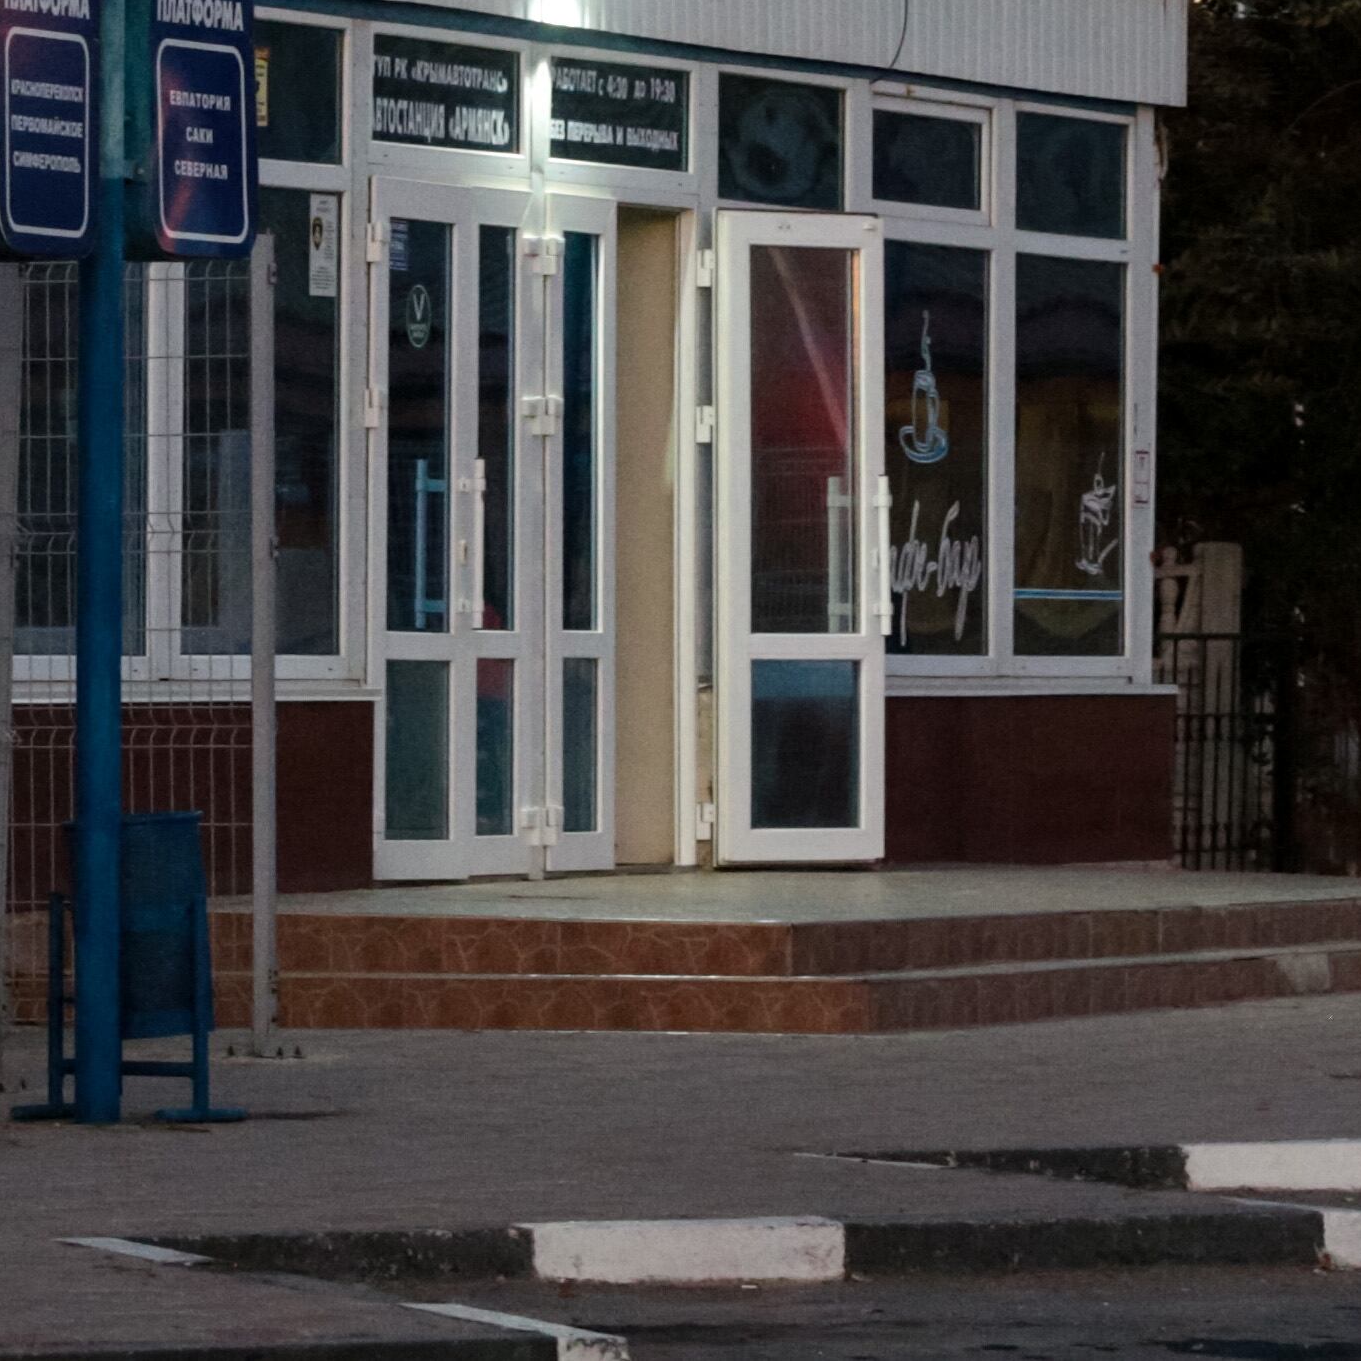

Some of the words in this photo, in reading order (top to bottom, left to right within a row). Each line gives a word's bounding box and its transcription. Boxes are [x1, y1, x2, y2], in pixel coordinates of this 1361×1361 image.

[11, 78, 84, 103] КРАСНОПЕРЕКОПСК
[170, 90, 231, 112] ЕВПАТОРИЯ
[11, 114, 84, 138] ПЕРВОМАЙСКОЕ
[373, 97, 445, 142] ВТОСТАНЦИЯ
[186, 126, 214, 144] САКИ
[13, 151, 82, 174] СИМФЕРОПОЛЬ
[174, 160, 228, 181] СЕВЕРНАЯ
